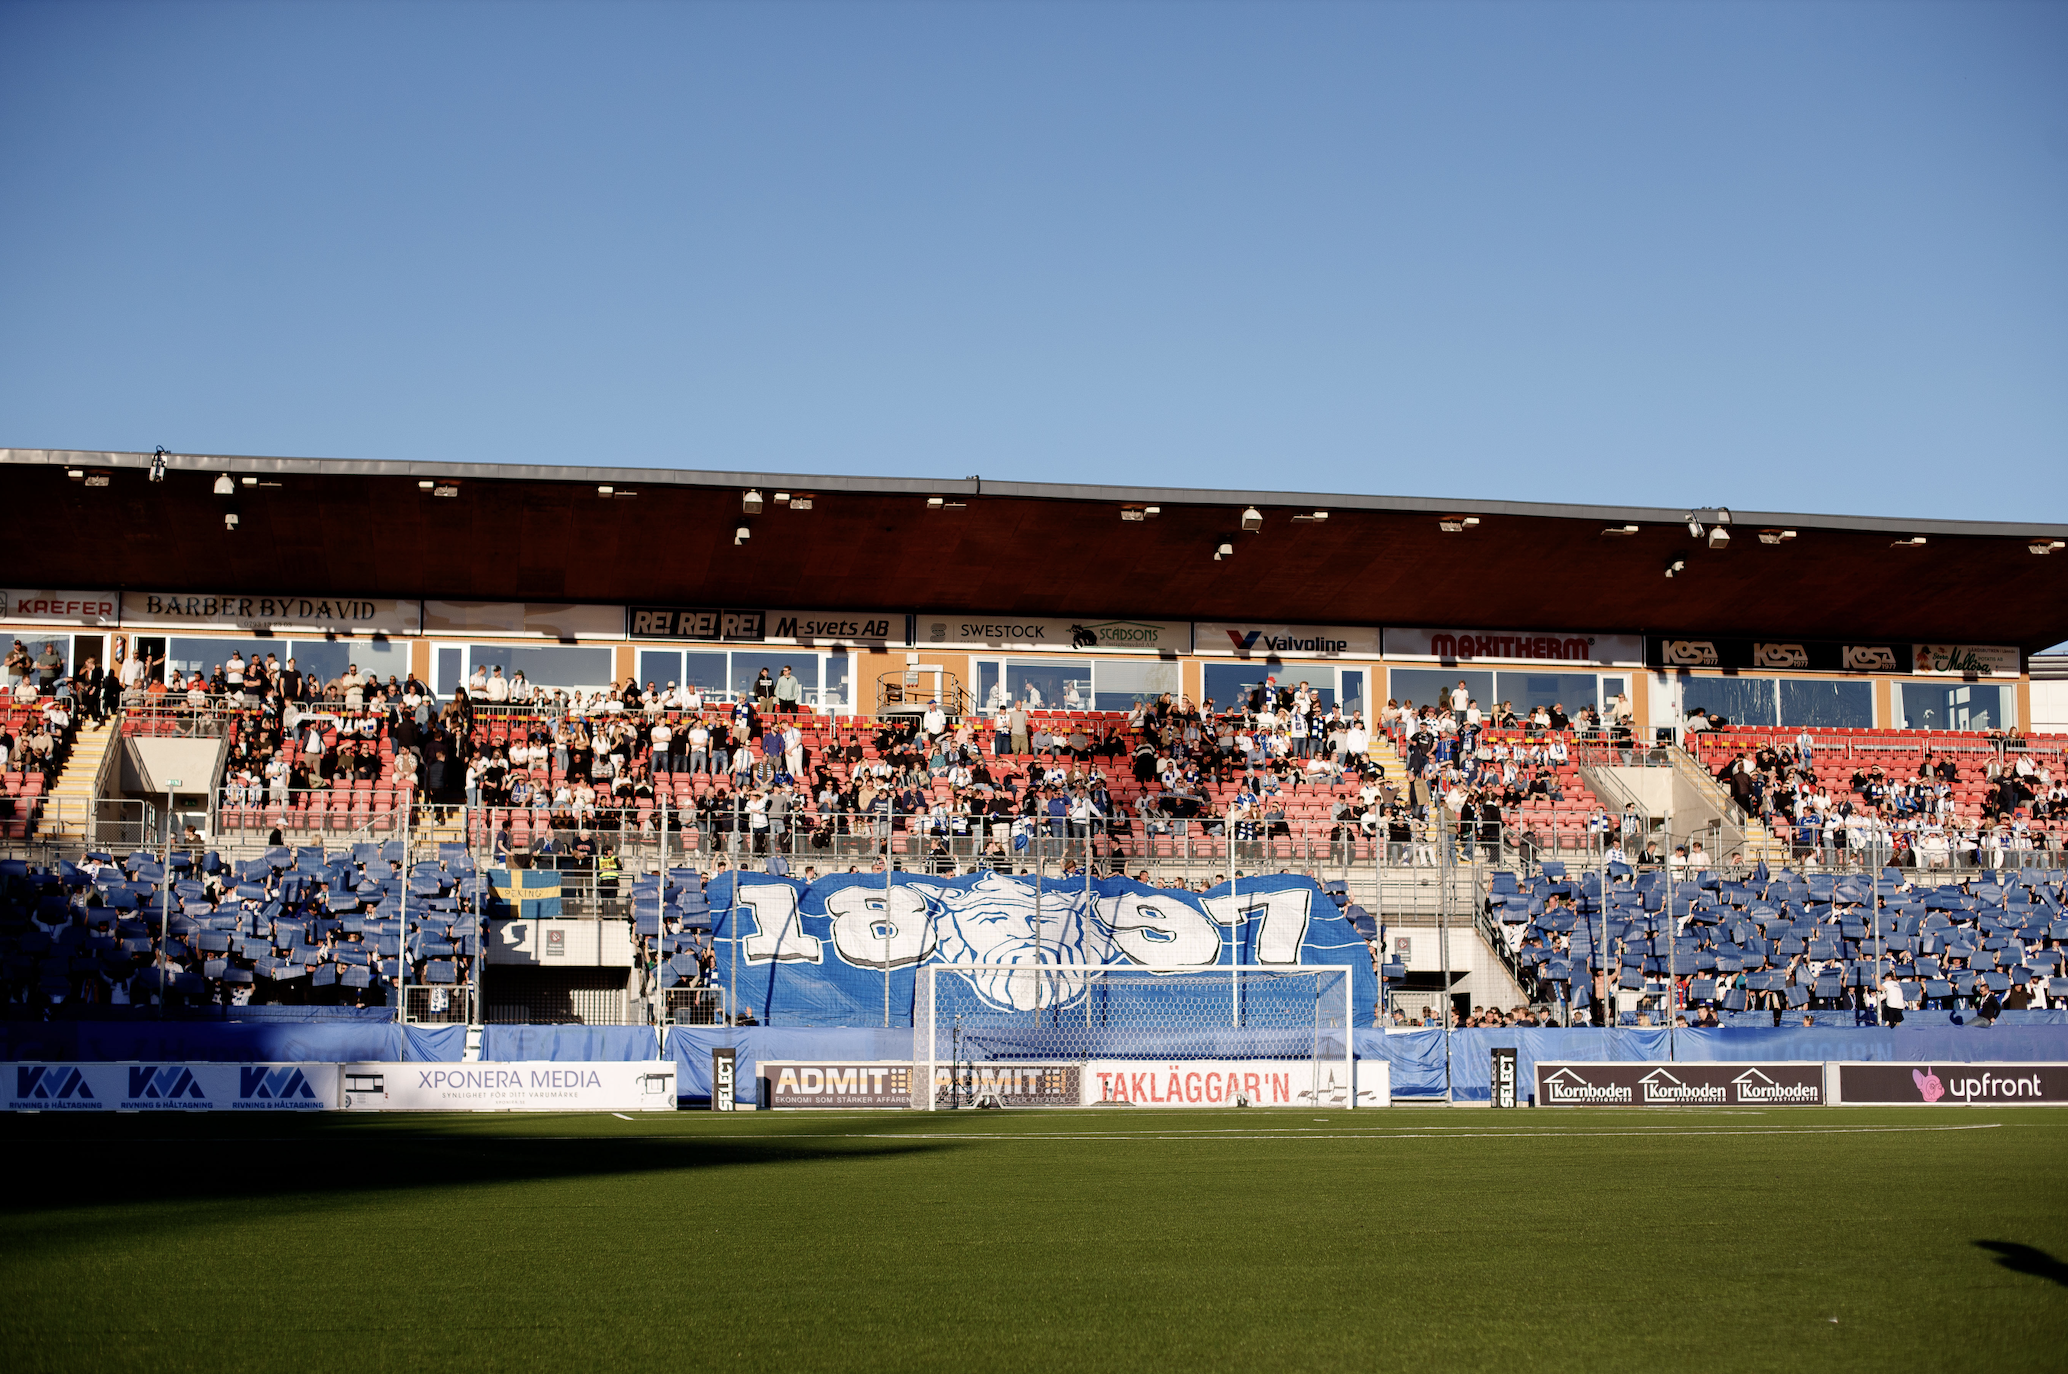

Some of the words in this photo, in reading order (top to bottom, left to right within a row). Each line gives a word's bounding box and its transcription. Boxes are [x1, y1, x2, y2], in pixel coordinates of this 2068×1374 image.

[18, 599, 113, 615] KAEFER
[633, 611, 673, 635] RE!
[677, 612, 717, 635] RE!
[722, 613, 762, 637] RE!
[774, 617, 858, 638] M-svets
[861, 620, 889, 637] AB
[961, 623, 1045, 638] SWESTOCK
[1264, 636, 1347, 652] Valvoline
[1662, 640, 1718, 664] KOSA
[1703, 657, 1718, 665] 1977
[1754, 643, 1808, 667] KOSA
[1842, 645, 1896, 670] KOSA
[418, 1070, 522, 1089] XPONERA
[531, 1070, 602, 1088] MEDIA
[718, 1056, 733, 1111] SELECT
[775, 1067, 889, 1094] ADMIT
[1097, 1065, 1290, 1103] TAKLÄGGAR'N
[1500, 1055, 1514, 1108] SELECT
[1950, 1072, 2043, 1102] upfront
[442, 1091, 487, 1099] SYNLIGHET
[529, 1090, 579, 1098] VARUMÄRKE
[1554, 1082, 1632, 1097] Kornboden
[1649, 1082, 1726, 1097] Kornboden
[1742, 1082, 1818, 1097] Kornboden
[9, 1101, 43, 1109] RIVNING
[44, 1101, 49, 1109] &
[51, 1100, 102, 1109] HÅLTAGNING
[120, 1101, 154, 1109] RIVNING
[156, 1101, 161, 1109] &
[163, 1100, 213, 1109] HÅLTAGNING
[232, 1101, 265, 1109] RIVNING
[267, 1101, 272, 1109] &
[274, 1100, 324, 1109] HÅLTAGNING
[775, 1096, 812, 1104] EKONOMI
[815, 1096, 834, 1104] SOM
[837, 1095, 873, 1104] STÄRKER
